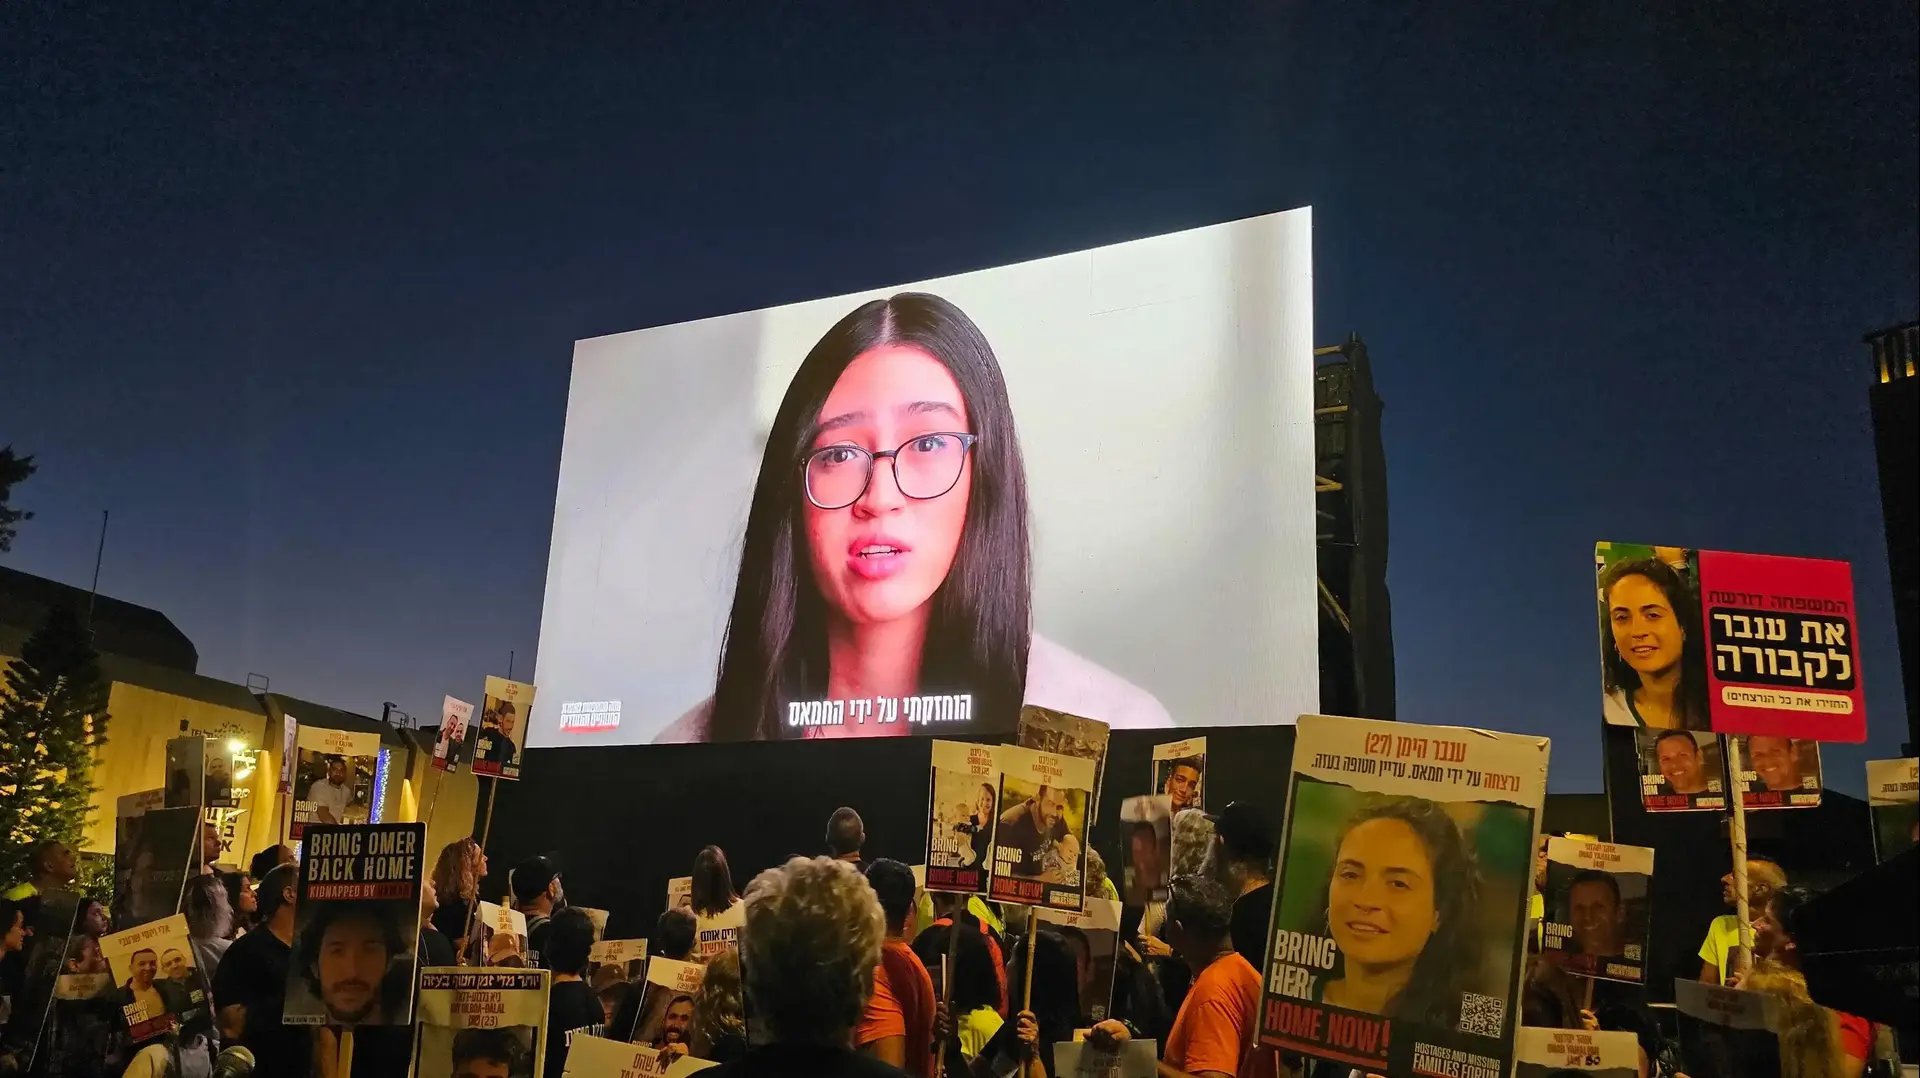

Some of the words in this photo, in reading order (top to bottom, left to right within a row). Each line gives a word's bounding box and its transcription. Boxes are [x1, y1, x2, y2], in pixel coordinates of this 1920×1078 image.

[1708, 590, 1763, 606] דורשת
[1770, 595, 1848, 613] המשפחה
[1713, 613, 1787, 641] ענבר
[1800, 621, 1846, 646] את
[1716, 644, 1851, 686] לקבורה
[1727, 691, 1775, 704] הנרצחים!
[1779, 695, 1791, 705] כל
[1796, 697, 1811, 706] את
[1816, 699, 1849, 709] החזירו
[788, 700, 845, 726] החמאס
[849, 699, 872, 724] ידי
[877, 695, 899, 724] על
[903, 694, 972, 725] הוחזקתי
[1365, 732, 1393, 756] (27)
[1397, 735, 1428, 760] הימן
[1433, 739, 1467, 763] ענבר
[1311, 753, 1341, 771] בעזה.
[1342, 756, 1376, 775] חטופה
[1379, 760, 1406, 778] עדיין
[1408, 764, 1443, 783] חמאס.
[1447, 767, 1463, 785] ידי
[1467, 769, 1481, 787] על
[1483, 772, 1521, 792] נרצחה
[1642, 774, 1665, 785] BRING
[1740, 771, 1757, 781] RING
[1644, 785, 1658, 795] HIM
[295, 800, 318, 812] BRING
[294, 811, 309, 823] HIM
[310, 832, 362, 857] BRING
[368, 831, 416, 855] OMER
[931, 838, 959, 853] BRING
[930, 852, 949, 867] HER
[996, 845, 1022, 864] BRING
[308, 857, 356, 881] BACK
[363, 856, 415, 880] HOME
[994, 861, 1012, 877] HIM
[309, 884, 360, 898] KIDNAPPED
[364, 885, 376, 897] BY
[993, 878, 1018, 894] HOME
[1019, 881, 1043, 898] NOW!
[700, 929, 720, 942] אותם
[1546, 922, 1573, 938] BRING
[1274, 929, 1337, 970] BRING
[1545, 935, 1562, 950] HIM
[423, 975, 450, 987] בעזה
[477, 975, 494, 990] זמן
[496, 975, 515, 987] מדי
[517, 975, 540, 989] יותר
[1264, 998, 1323, 1041] HOME
[1326, 1012, 1391, 1057] NOW!
[633, 1053, 655, 1072] שהם
[1414, 1042, 1451, 1060] HOSTAGES
[1451, 1050, 1467, 1063] AND
[1467, 1053, 1500, 1070] MISSING
[1413, 1053, 1460, 1078] FAMILIES
